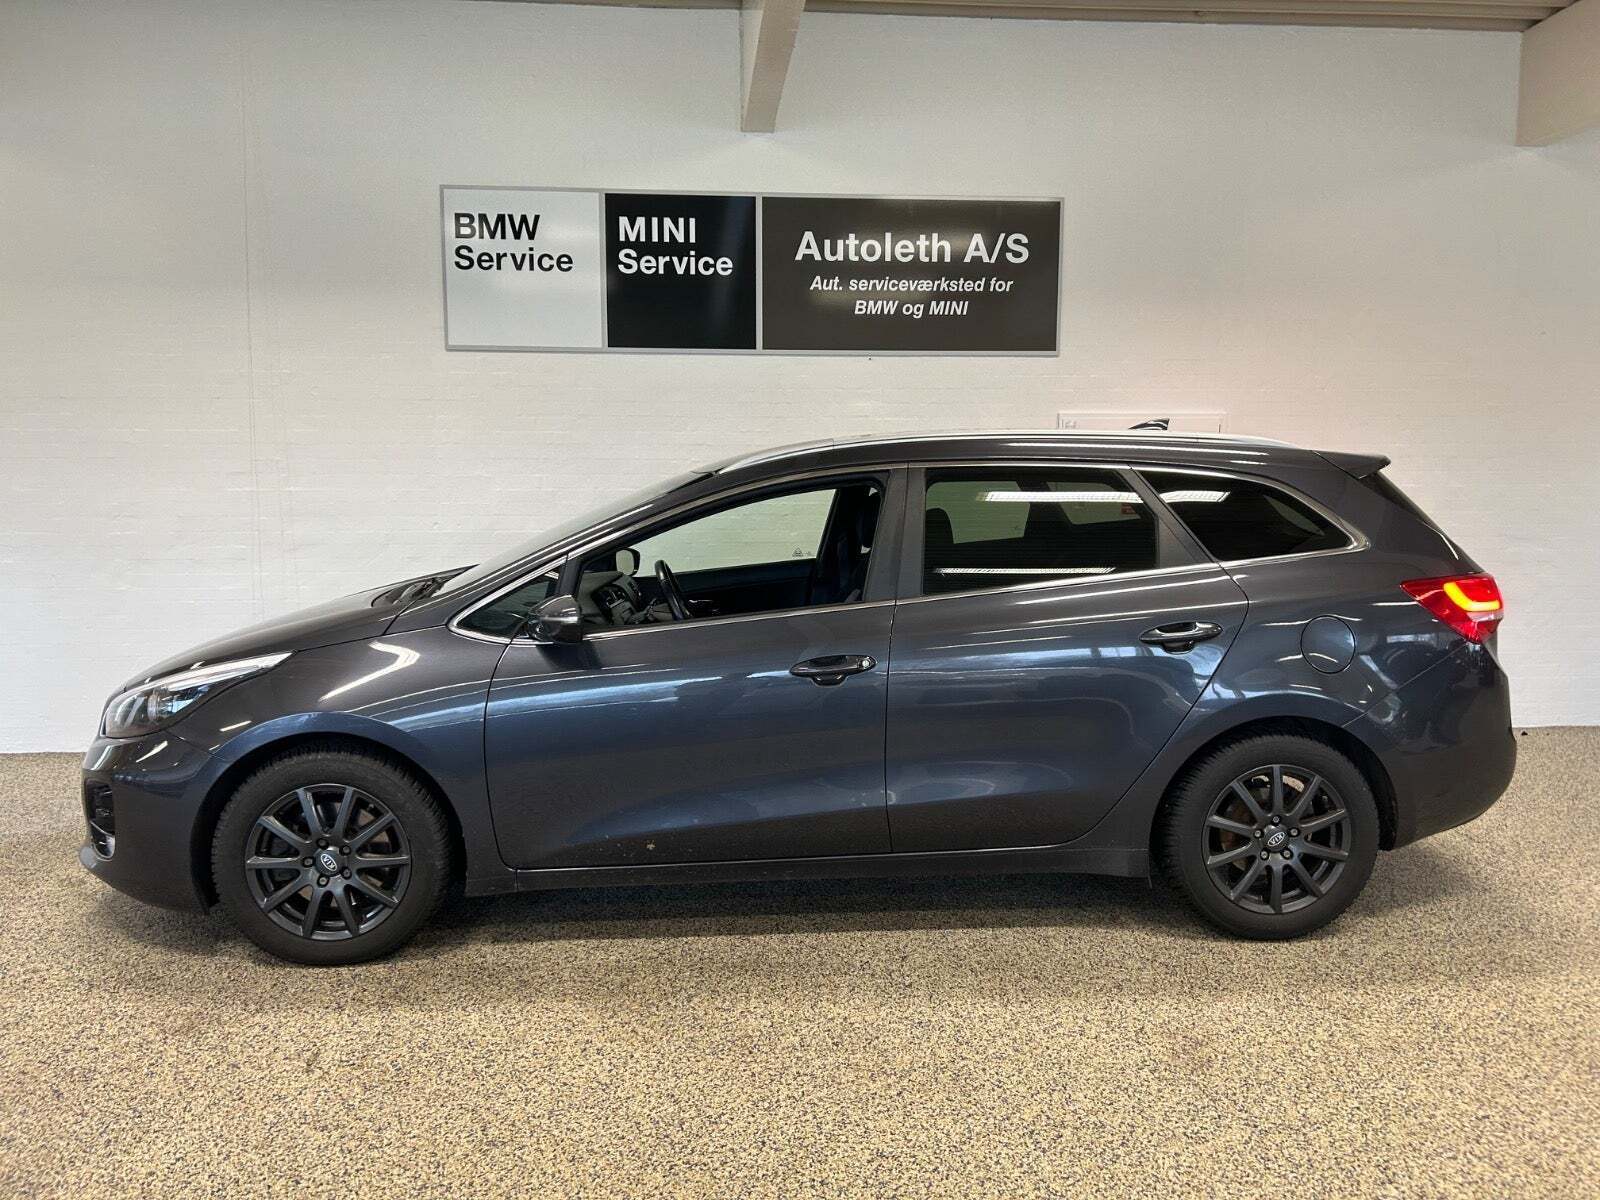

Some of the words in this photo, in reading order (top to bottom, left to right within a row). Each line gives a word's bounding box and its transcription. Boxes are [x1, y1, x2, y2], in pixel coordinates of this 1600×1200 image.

[454, 212, 541, 241] BMW
[618, 215, 696, 244] MINI
[454, 244, 574, 273] Service
[794, 231, 952, 263] Autoleth
[963, 232, 1030, 264] A/S
[617, 248, 734, 276] Service
[809, 275, 843, 292] Aut.
[848, 275, 986, 292] serviceværksted
[989, 276, 1014, 292] for
[854, 299, 900, 315] BMW
[902, 303, 925, 319] og
[928, 300, 970, 316] MINI
[1269, 832, 1284, 845] KIA
[322, 855, 336, 870] KIA
